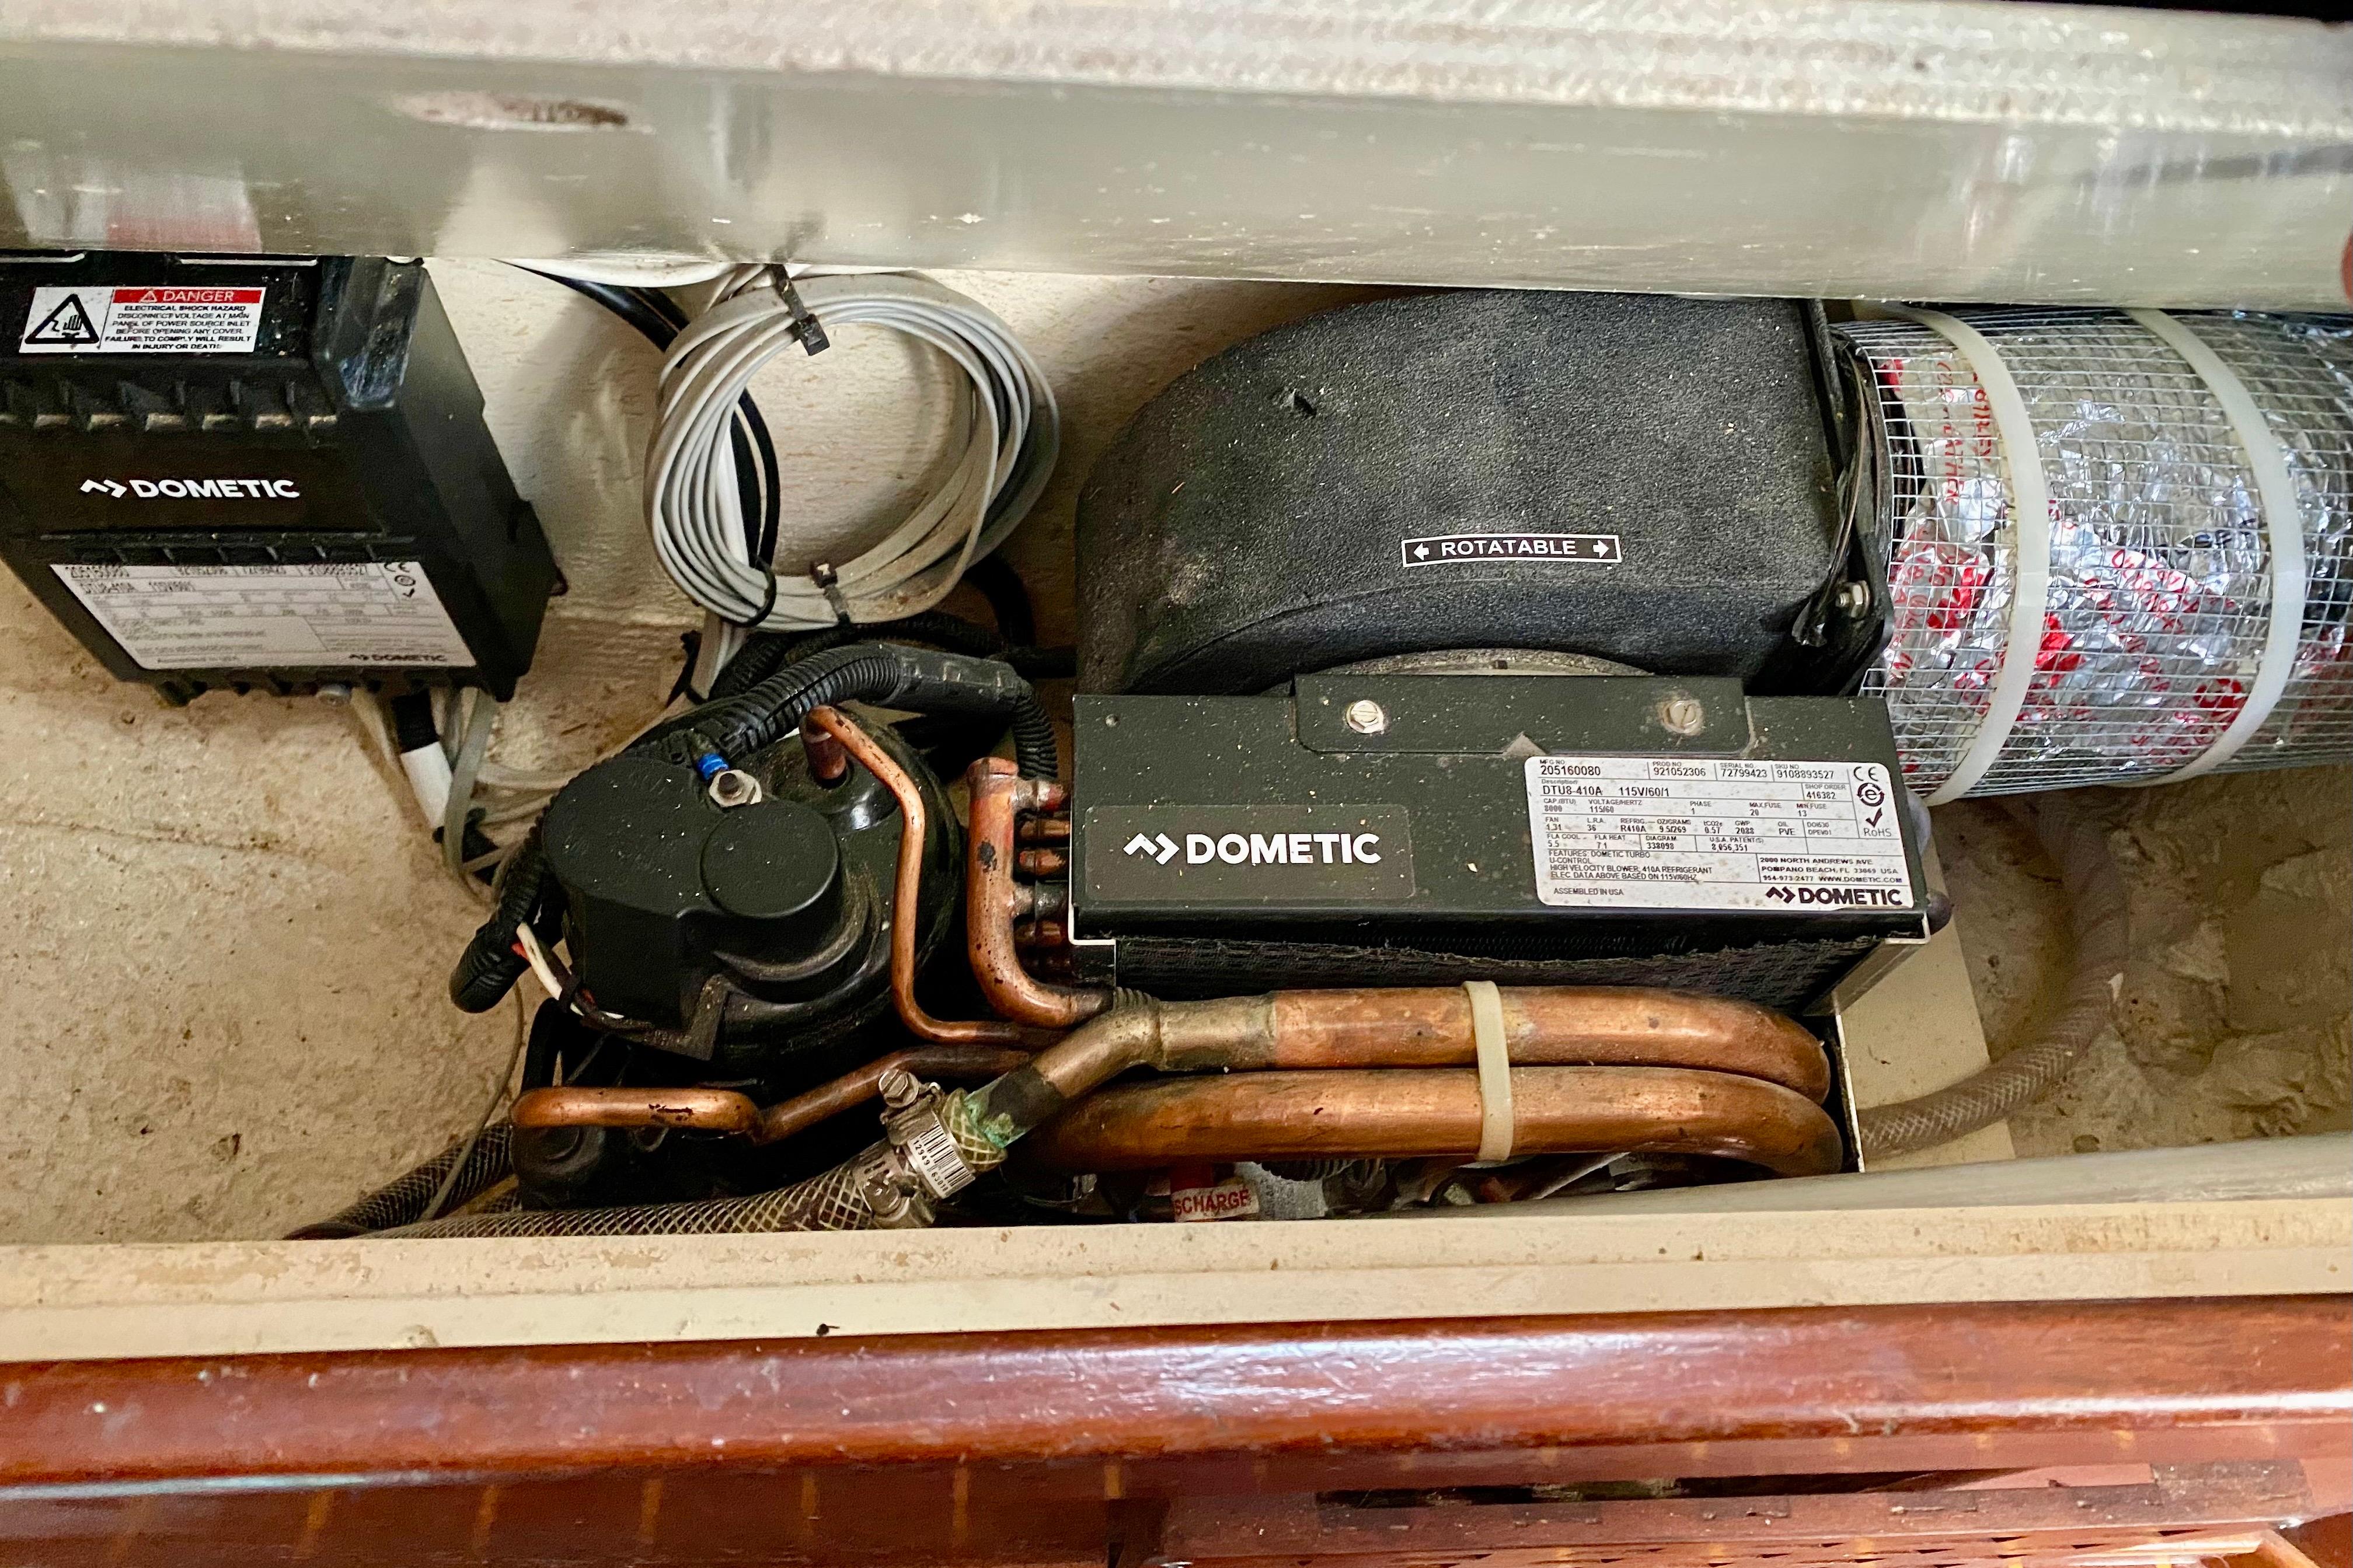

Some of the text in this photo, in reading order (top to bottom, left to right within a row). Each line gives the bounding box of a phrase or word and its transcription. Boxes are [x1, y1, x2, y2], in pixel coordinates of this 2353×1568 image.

[162, 291, 234, 302] DANGER
[129, 479, 300, 498] DOMETIC
[1441, 540, 1577, 556] ROTATABLE
[1540, 765, 1601, 776] 205160080
[1654, 767, 1706, 776] 921052306
[1721, 769, 1767, 778] 72799423
[1777, 769, 1834, 779] 9108893527
[1543, 785, 1669, 797] DTU8-410A 115V/60/1
[1864, 829, 1891, 837] RoHS
[1187, 833, 1382, 864] DOMETIC
[1798, 887, 1903, 905] DOMETIC
